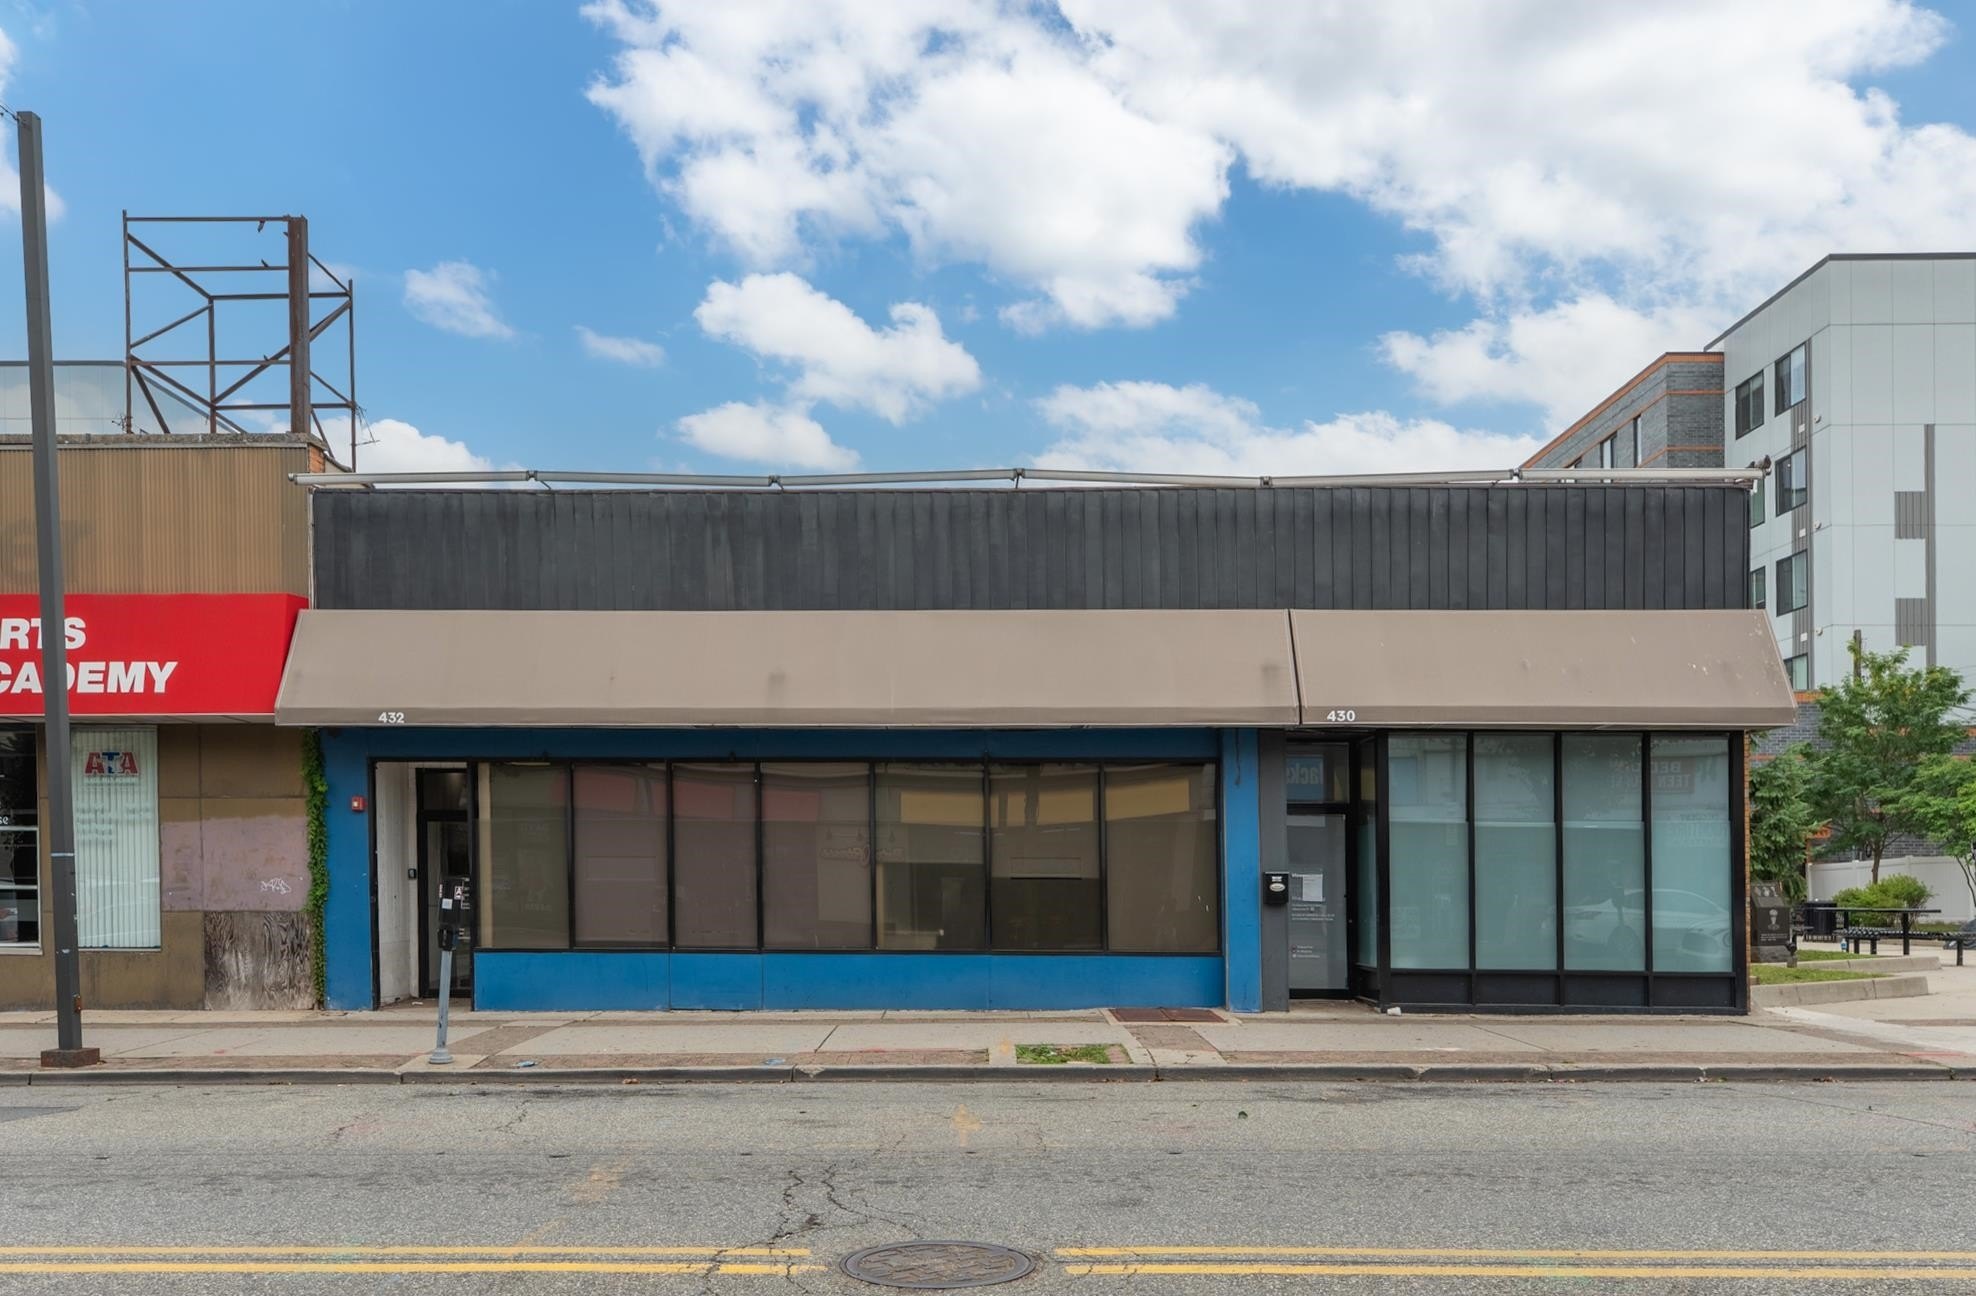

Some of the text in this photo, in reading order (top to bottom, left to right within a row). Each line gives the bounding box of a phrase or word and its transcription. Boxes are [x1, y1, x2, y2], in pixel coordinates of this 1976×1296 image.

[0, 661, 178, 694] AEMY
[378, 711, 405, 724] 432
[1326, 709, 1356, 722] 430
[84, 751, 140, 776] ATA
